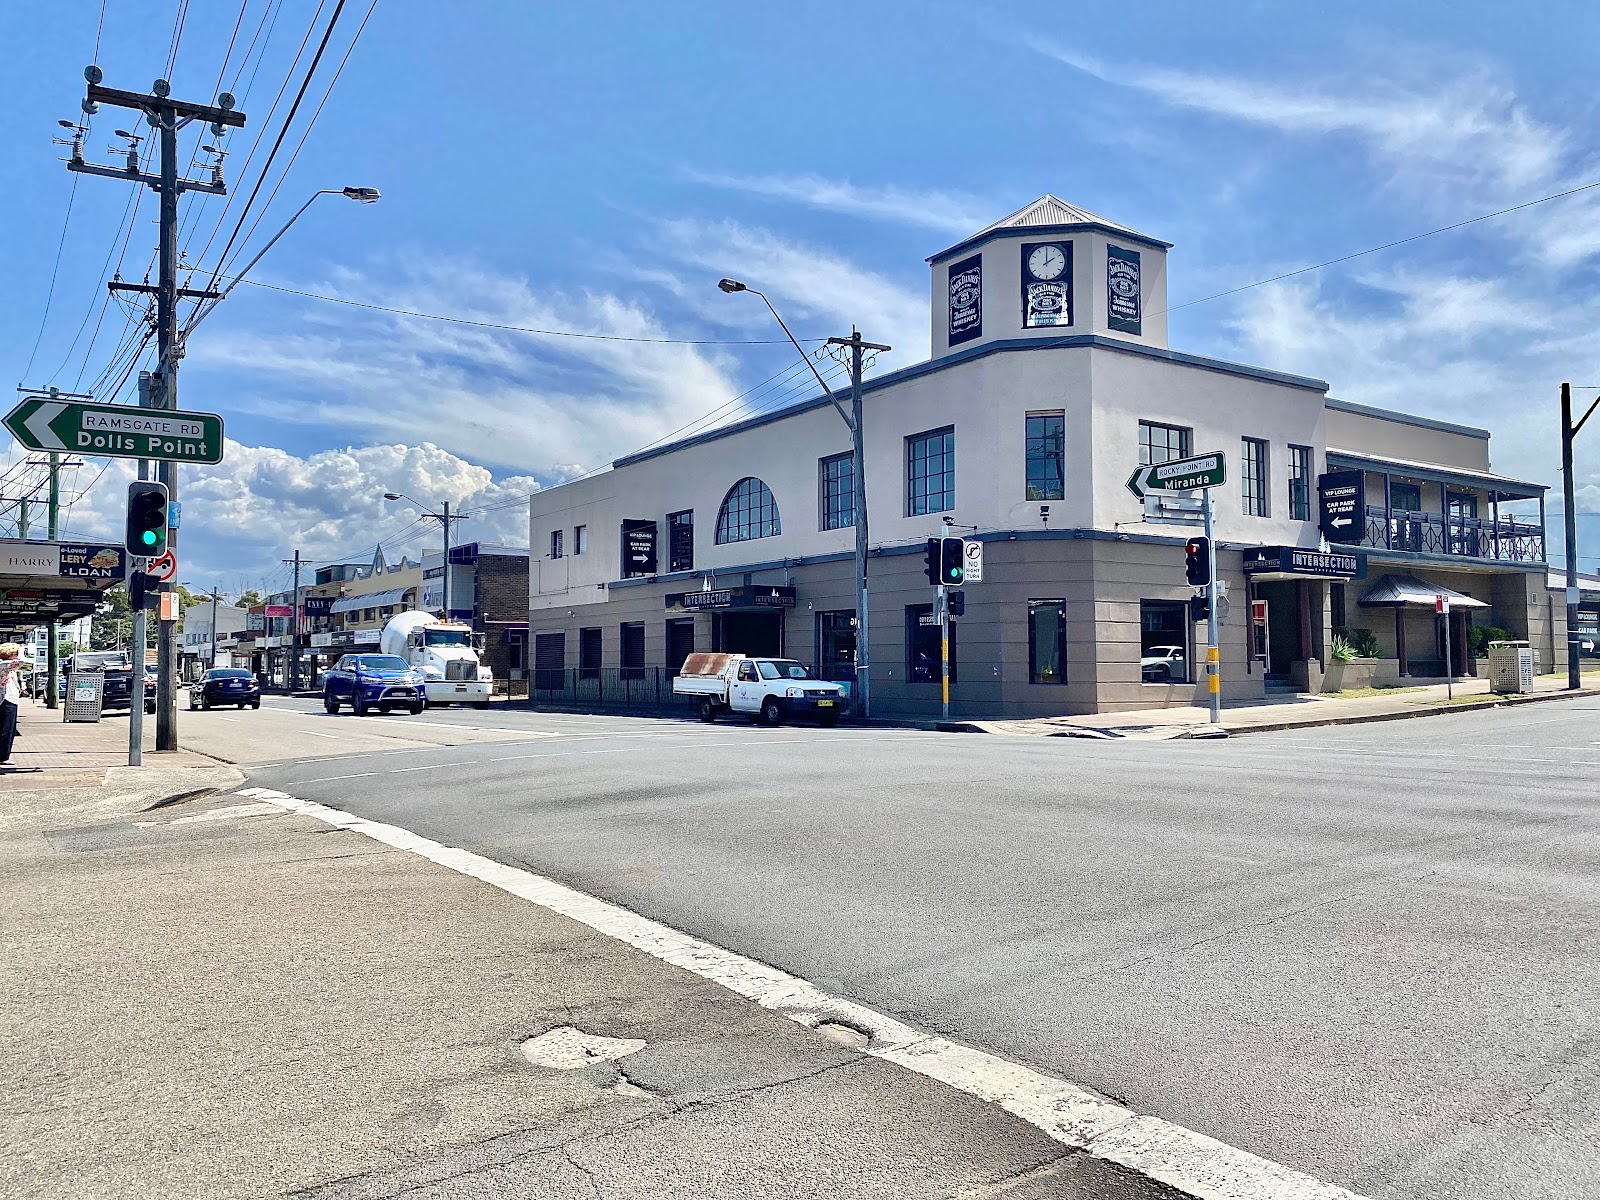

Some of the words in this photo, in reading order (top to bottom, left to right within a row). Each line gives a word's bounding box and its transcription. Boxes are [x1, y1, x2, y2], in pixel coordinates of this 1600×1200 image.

[86, 415, 172, 433] RAMSGATE
[181, 424, 201, 436] RD
[77, 431, 135, 450] Dolls
[148, 436, 207, 456] Point
[1159, 466, 1180, 477] ROCKY
[1182, 462, 1202, 472] POINT
[1205, 460, 1215, 468] RD
[1164, 475, 1210, 490] Miranda
[1335, 487, 1356, 496] LOUNGE
[1338, 505, 1354, 513] REAR
[9, 557, 55, 567] HARRY
[61, 555, 87, 565] LERY
[1292, 553, 1358, 571] INTERSECTION
[60, 568, 112, 578] -LOAN
[684, 591, 731, 606] INTERSECTION
